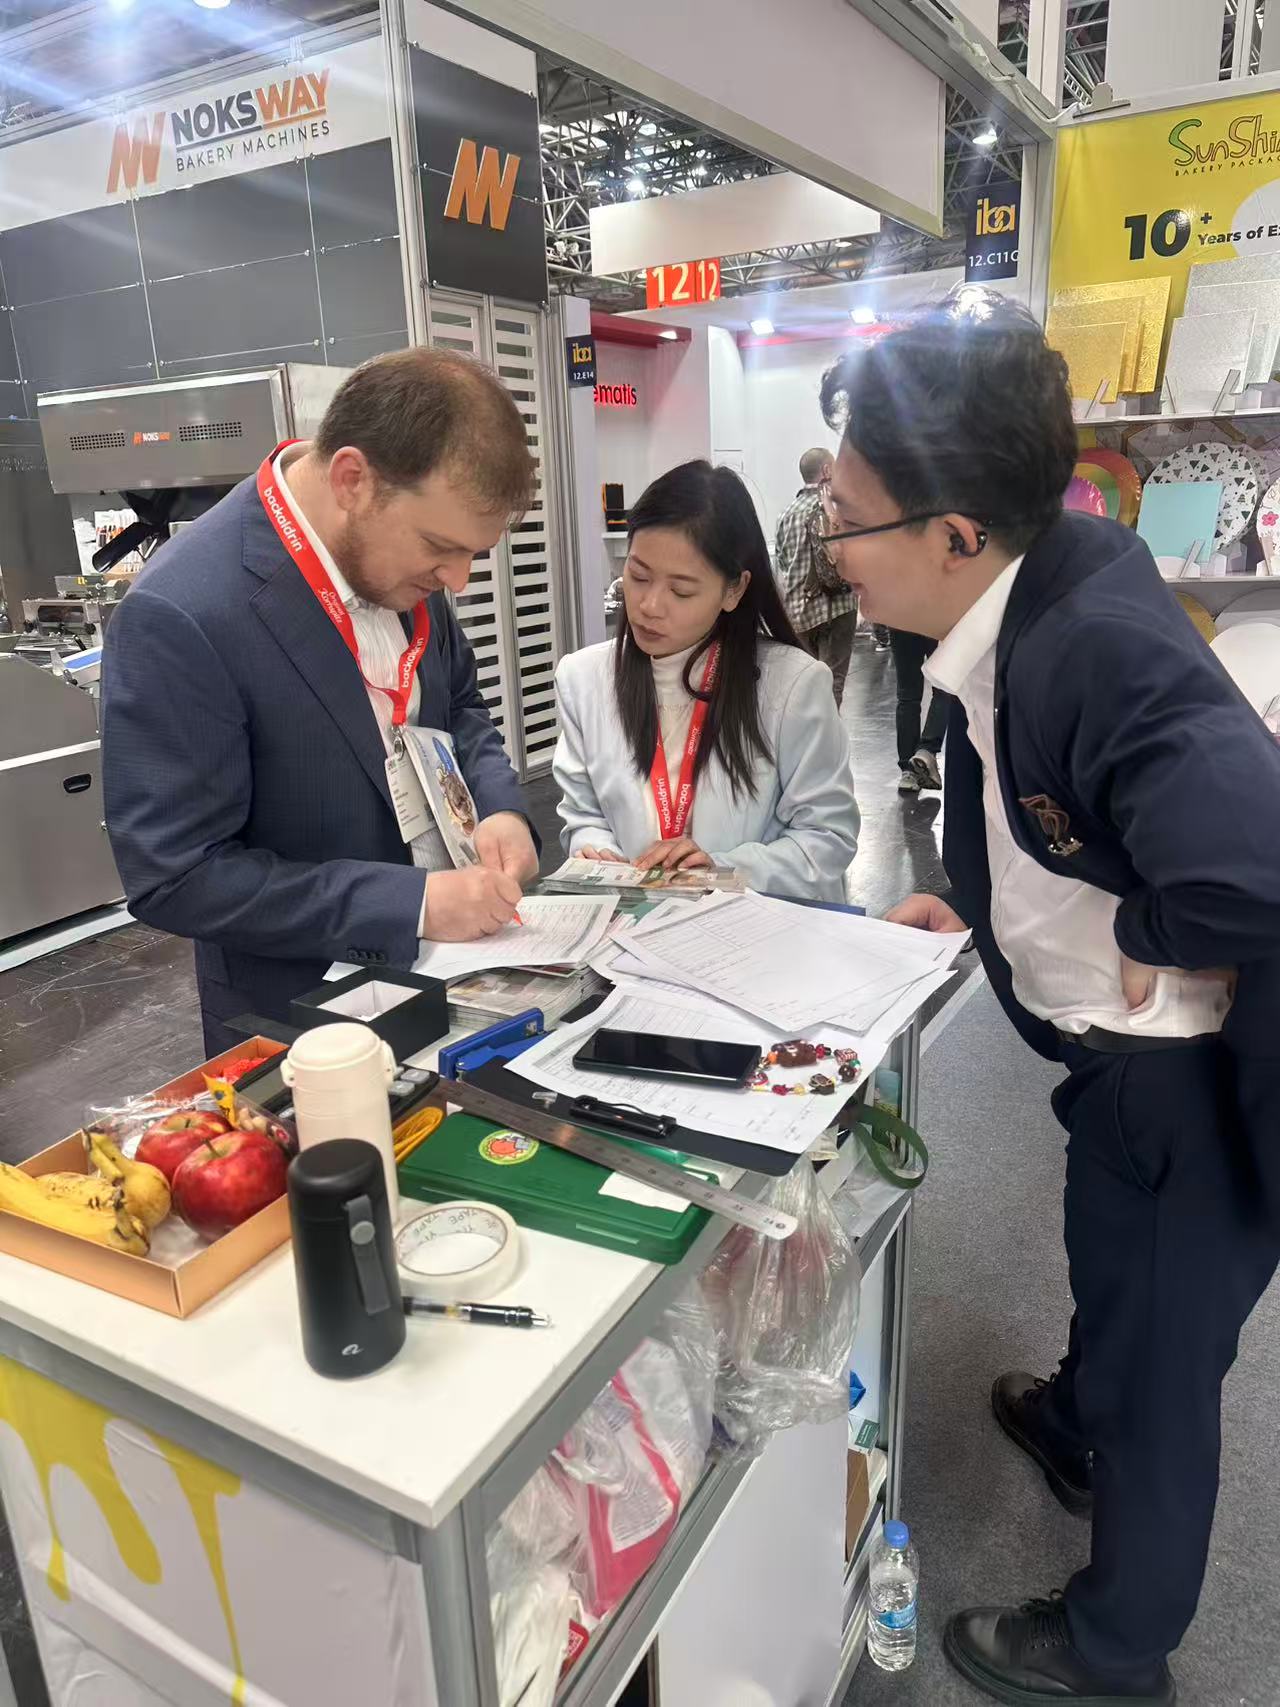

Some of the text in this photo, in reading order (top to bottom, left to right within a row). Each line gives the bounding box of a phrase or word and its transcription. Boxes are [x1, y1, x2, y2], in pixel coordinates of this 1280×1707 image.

[171, 67, 330, 146] NOKSWAY
[177, 120, 331, 172] BAKERY MACHINES
[1168, 114, 1280, 167] SunShi
[1175, 163, 1223, 177] BAKERY
[976, 197, 1016, 236] iba
[1197, 231, 1242, 246] Years
[1246, 226, 1264, 240] of
[1267, 224, 1280, 237] E
[652, 262, 690, 303] 12
[698, 260, 719, 301] 12
[572, 342, 593, 364] iba
[573, 371, 594, 381] 12.E14
[264, 487, 303, 552] backaldrin
[674, 783, 691, 834] backaldrin
